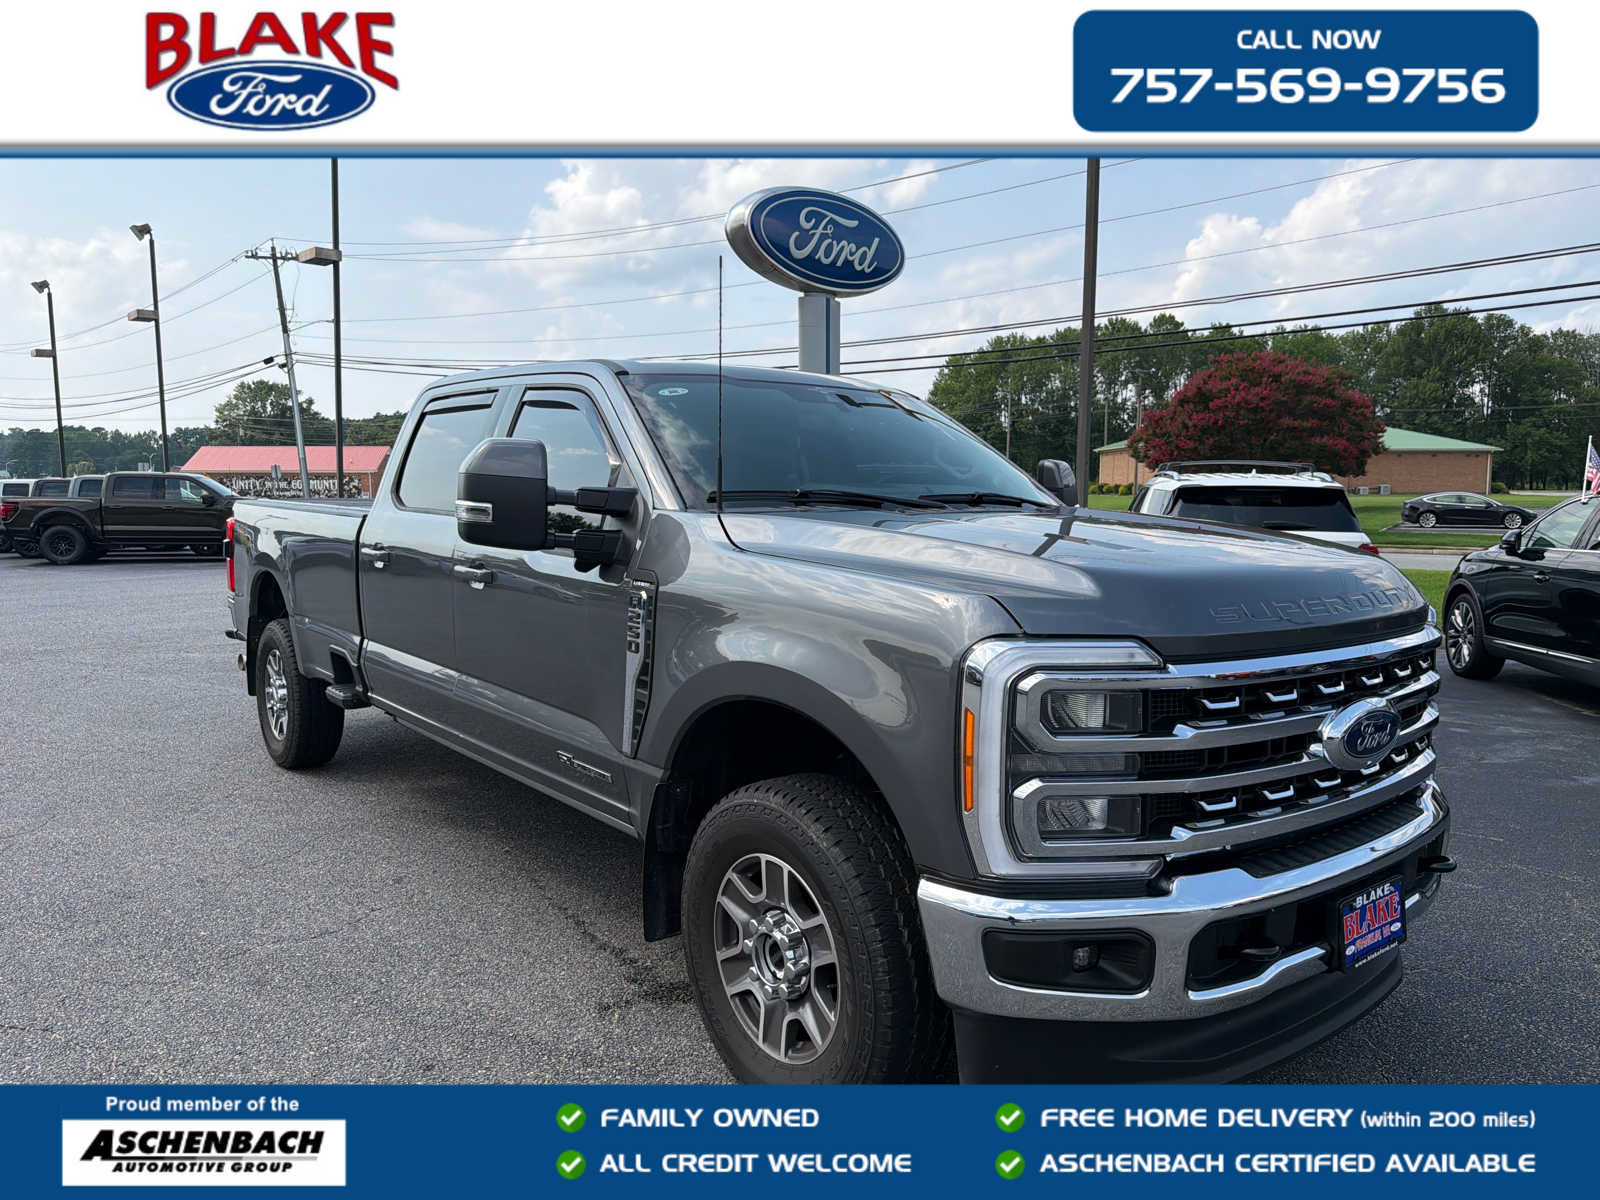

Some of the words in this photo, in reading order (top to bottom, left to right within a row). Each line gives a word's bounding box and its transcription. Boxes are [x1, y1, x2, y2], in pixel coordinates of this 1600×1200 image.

[788, 206, 881, 274] Ford
[1356, 719, 1392, 752] Ford
[1355, 883, 1391, 909] BLAKE
[1343, 891, 1401, 945] BLAKE
